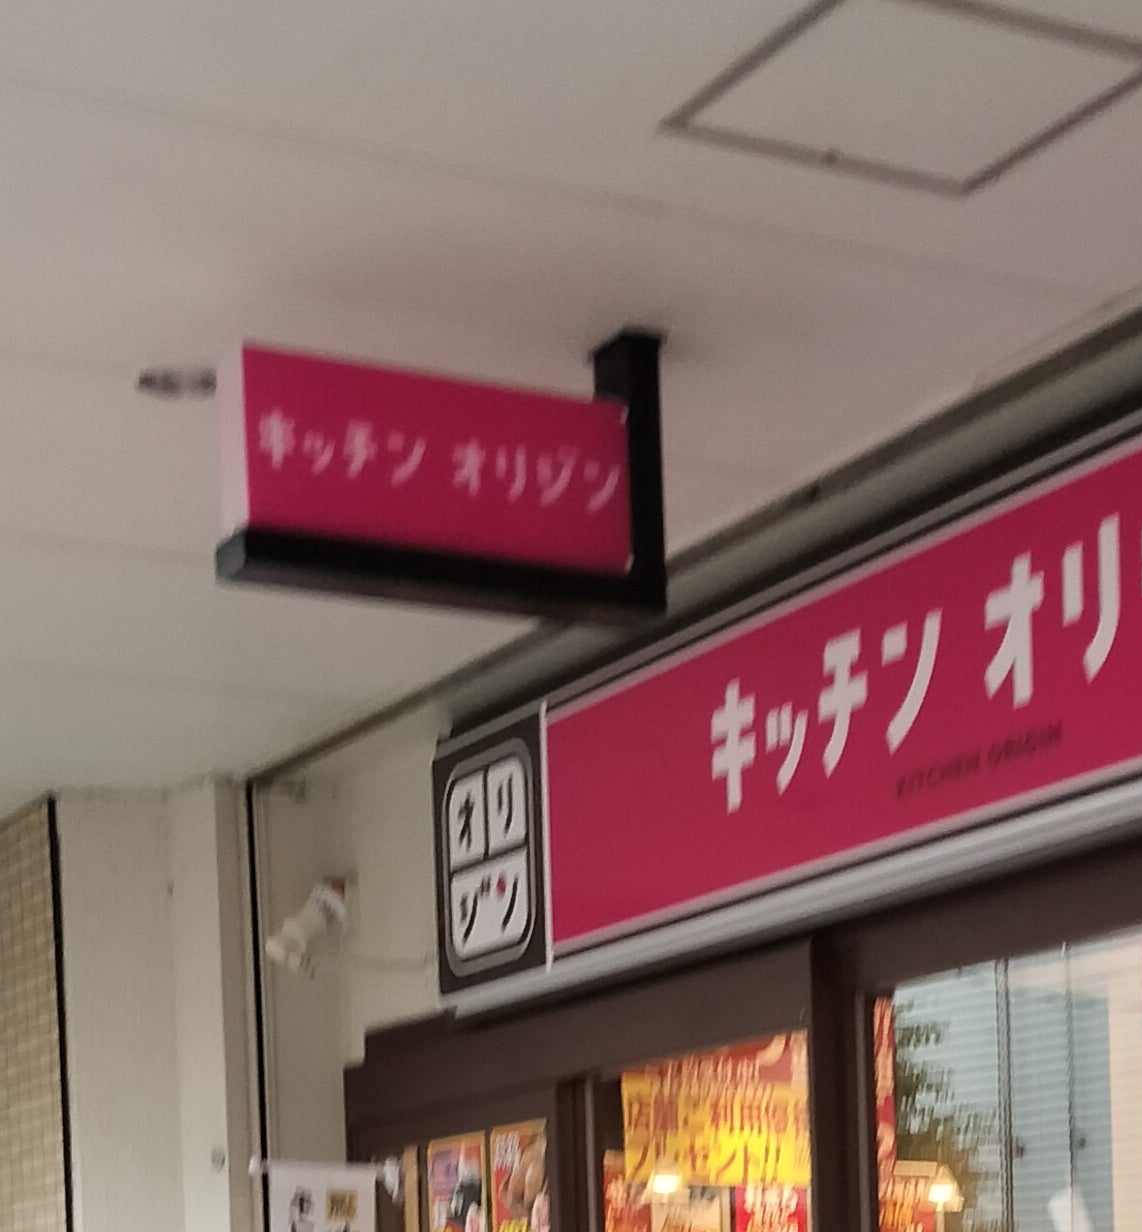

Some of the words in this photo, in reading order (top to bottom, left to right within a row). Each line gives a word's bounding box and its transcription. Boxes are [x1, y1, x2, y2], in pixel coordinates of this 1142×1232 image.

[258, 408, 426, 487] キッチン
[452, 437, 620, 514] オリジン
[711, 608, 942, 814] キッチン
[458, 772, 514, 851] オリ
